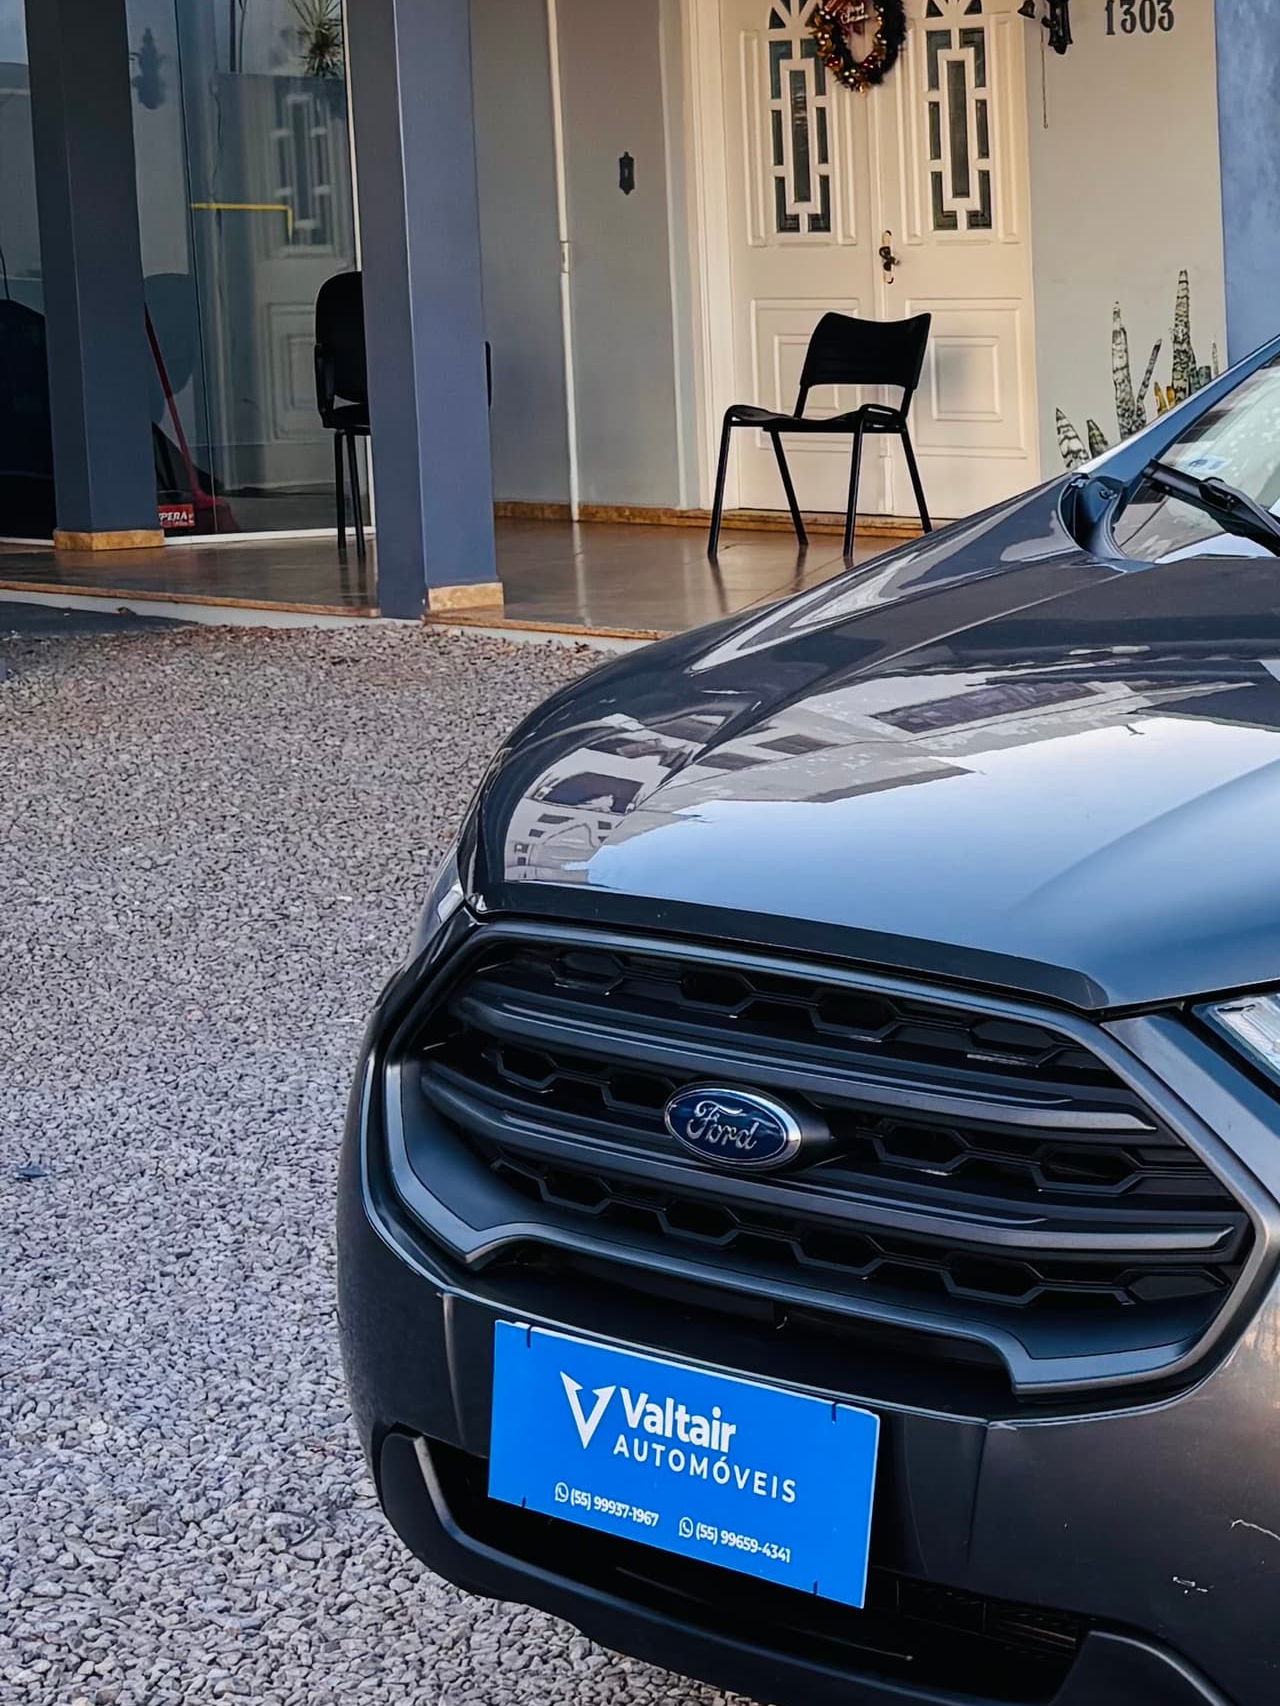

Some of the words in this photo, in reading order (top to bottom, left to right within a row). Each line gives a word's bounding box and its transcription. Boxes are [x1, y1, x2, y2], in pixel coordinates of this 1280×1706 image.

[686, 1100, 760, 1150] Ford
[619, 1387, 737, 1454] Valtair
[613, 1434, 797, 1504] AUTOMÓVEIS
[570, 1487, 592, 1511] (55)
[594, 1496, 659, 1527] 99937-1967
[695, 1521, 718, 1546] (55)
[720, 1530, 790, 1563] 99659-4341
